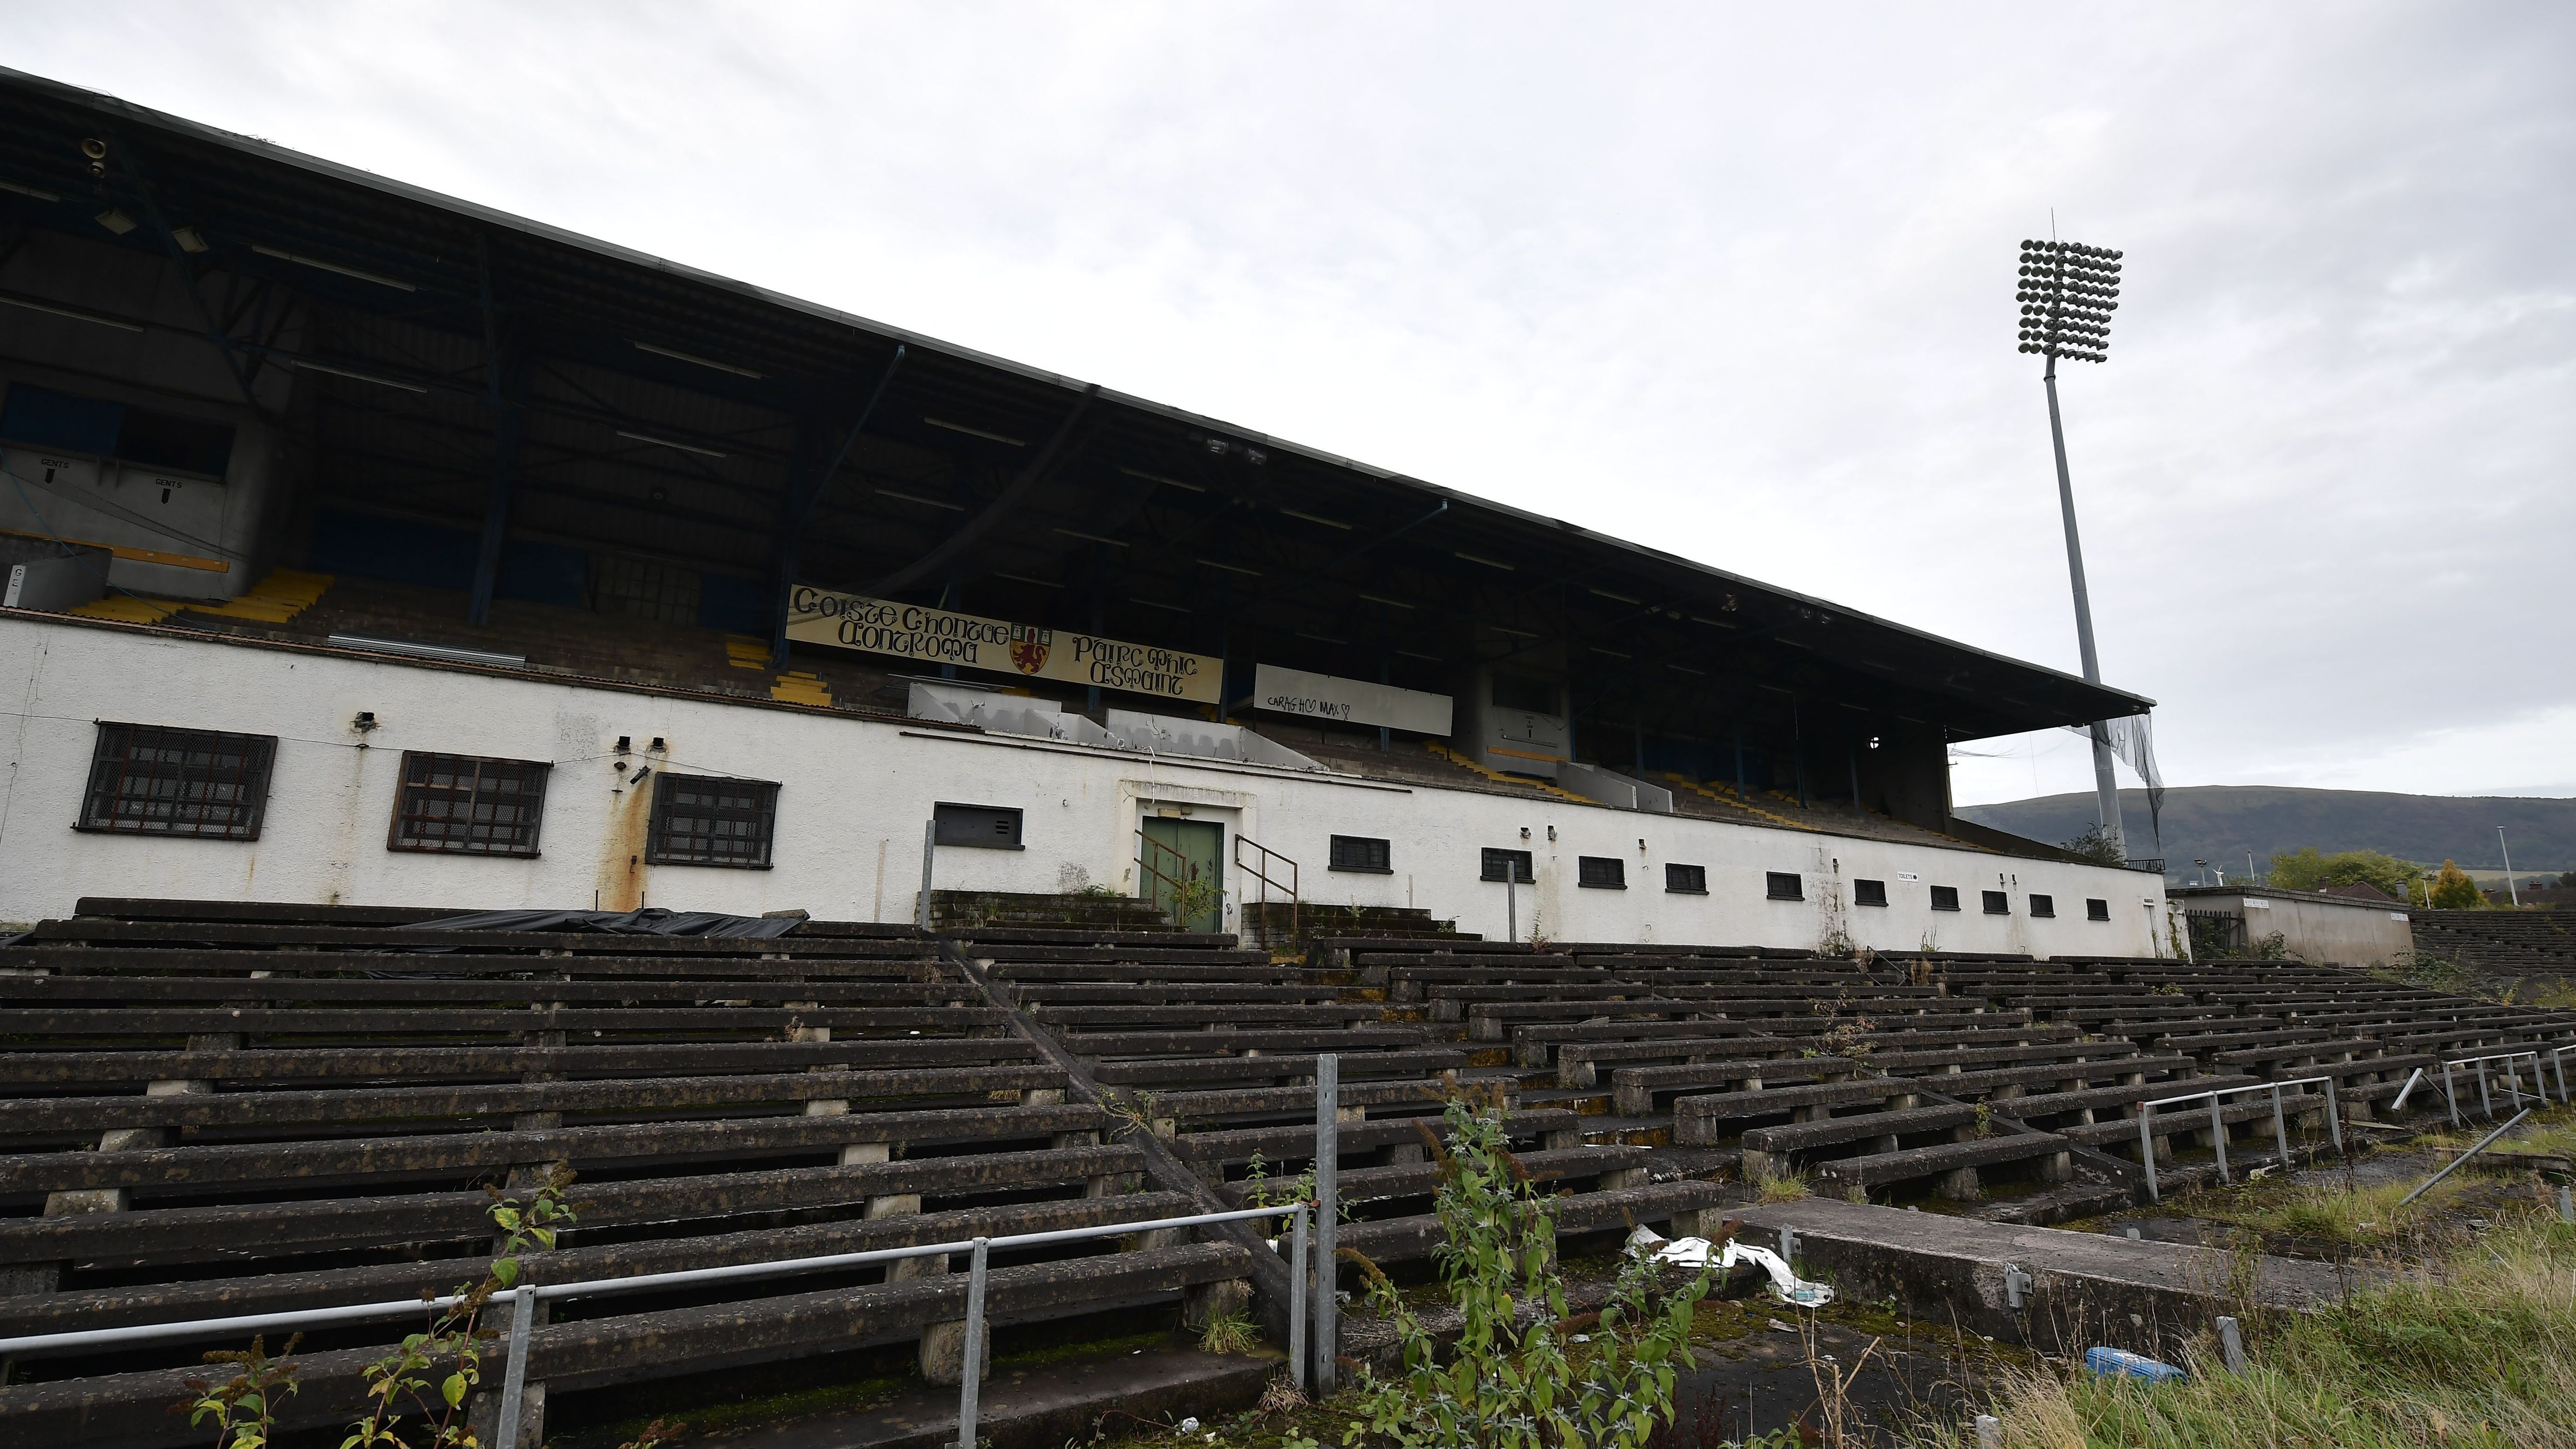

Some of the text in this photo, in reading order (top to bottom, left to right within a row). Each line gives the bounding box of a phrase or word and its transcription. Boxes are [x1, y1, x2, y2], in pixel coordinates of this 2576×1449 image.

[41, 458, 69, 469] GENTS
[156, 479, 182, 488] GENTS
[1319, 701, 1339, 717] MAX
